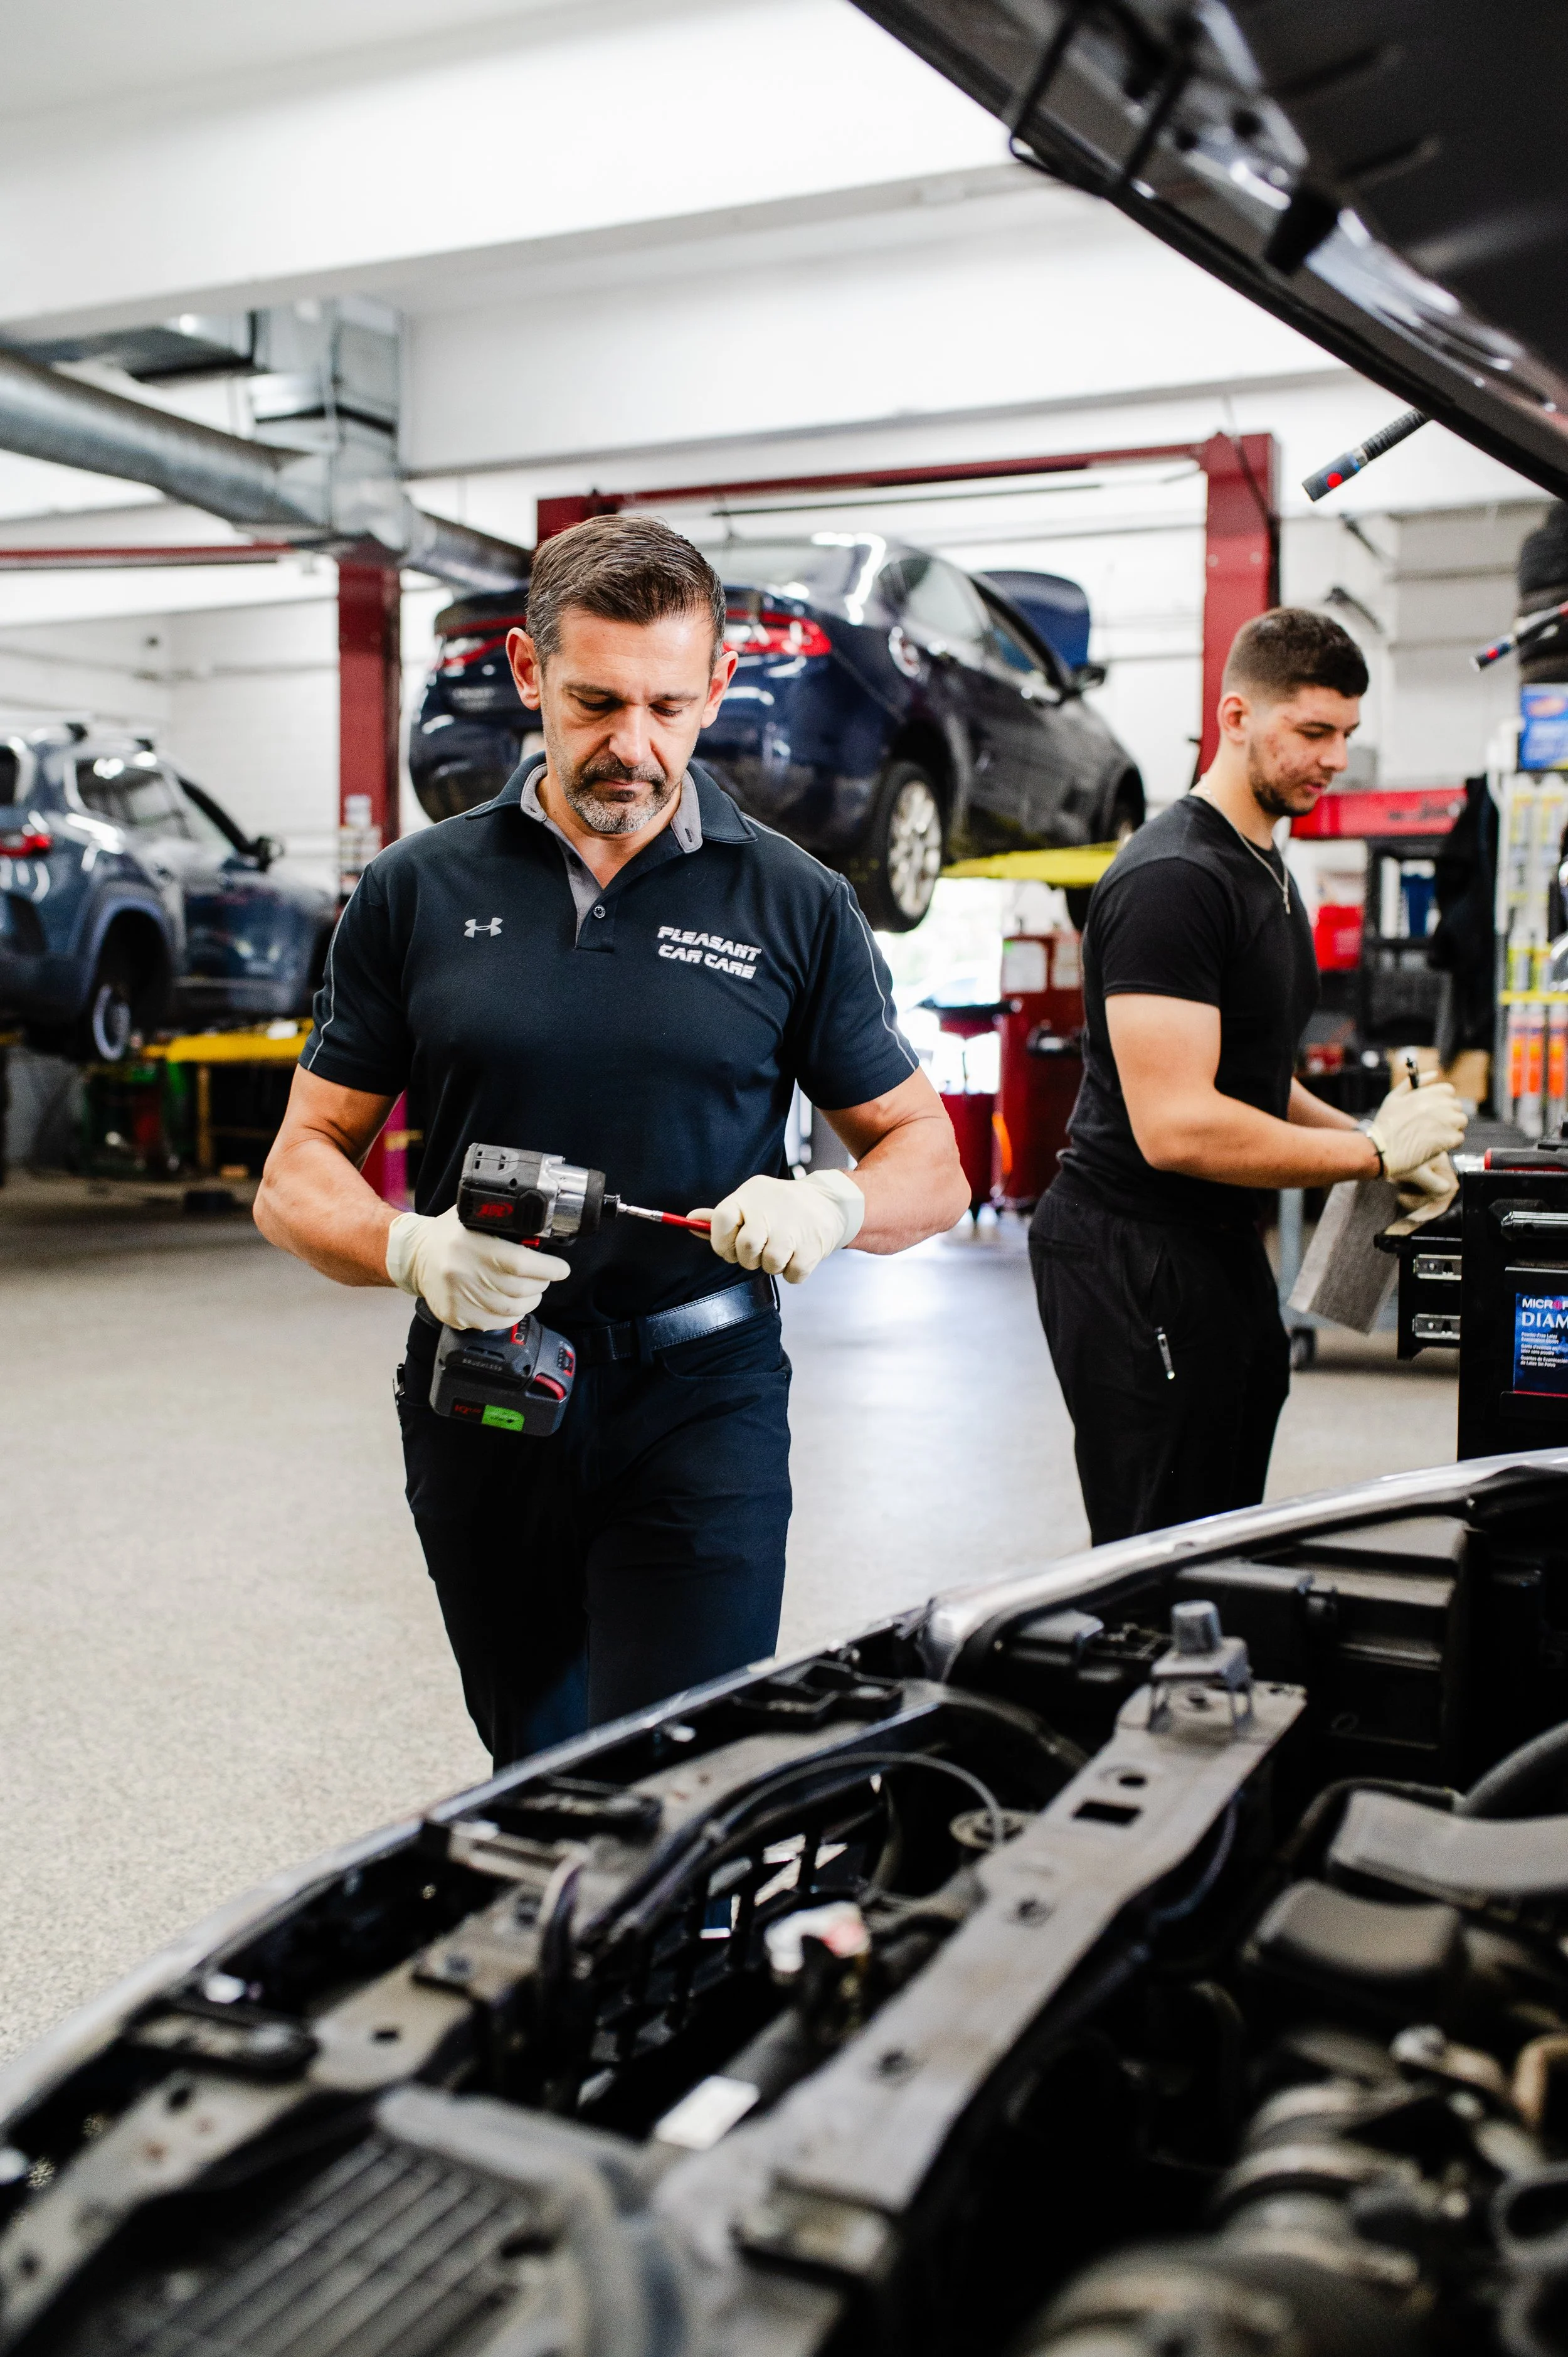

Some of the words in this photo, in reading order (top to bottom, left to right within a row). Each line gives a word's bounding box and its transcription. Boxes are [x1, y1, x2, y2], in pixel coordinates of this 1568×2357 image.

[657, 925, 762, 962] PLEASANT
[658, 944, 704, 964] CAR
[704, 952, 757, 979] CARE
[1522, 1311, 1568, 1329] DIAM
